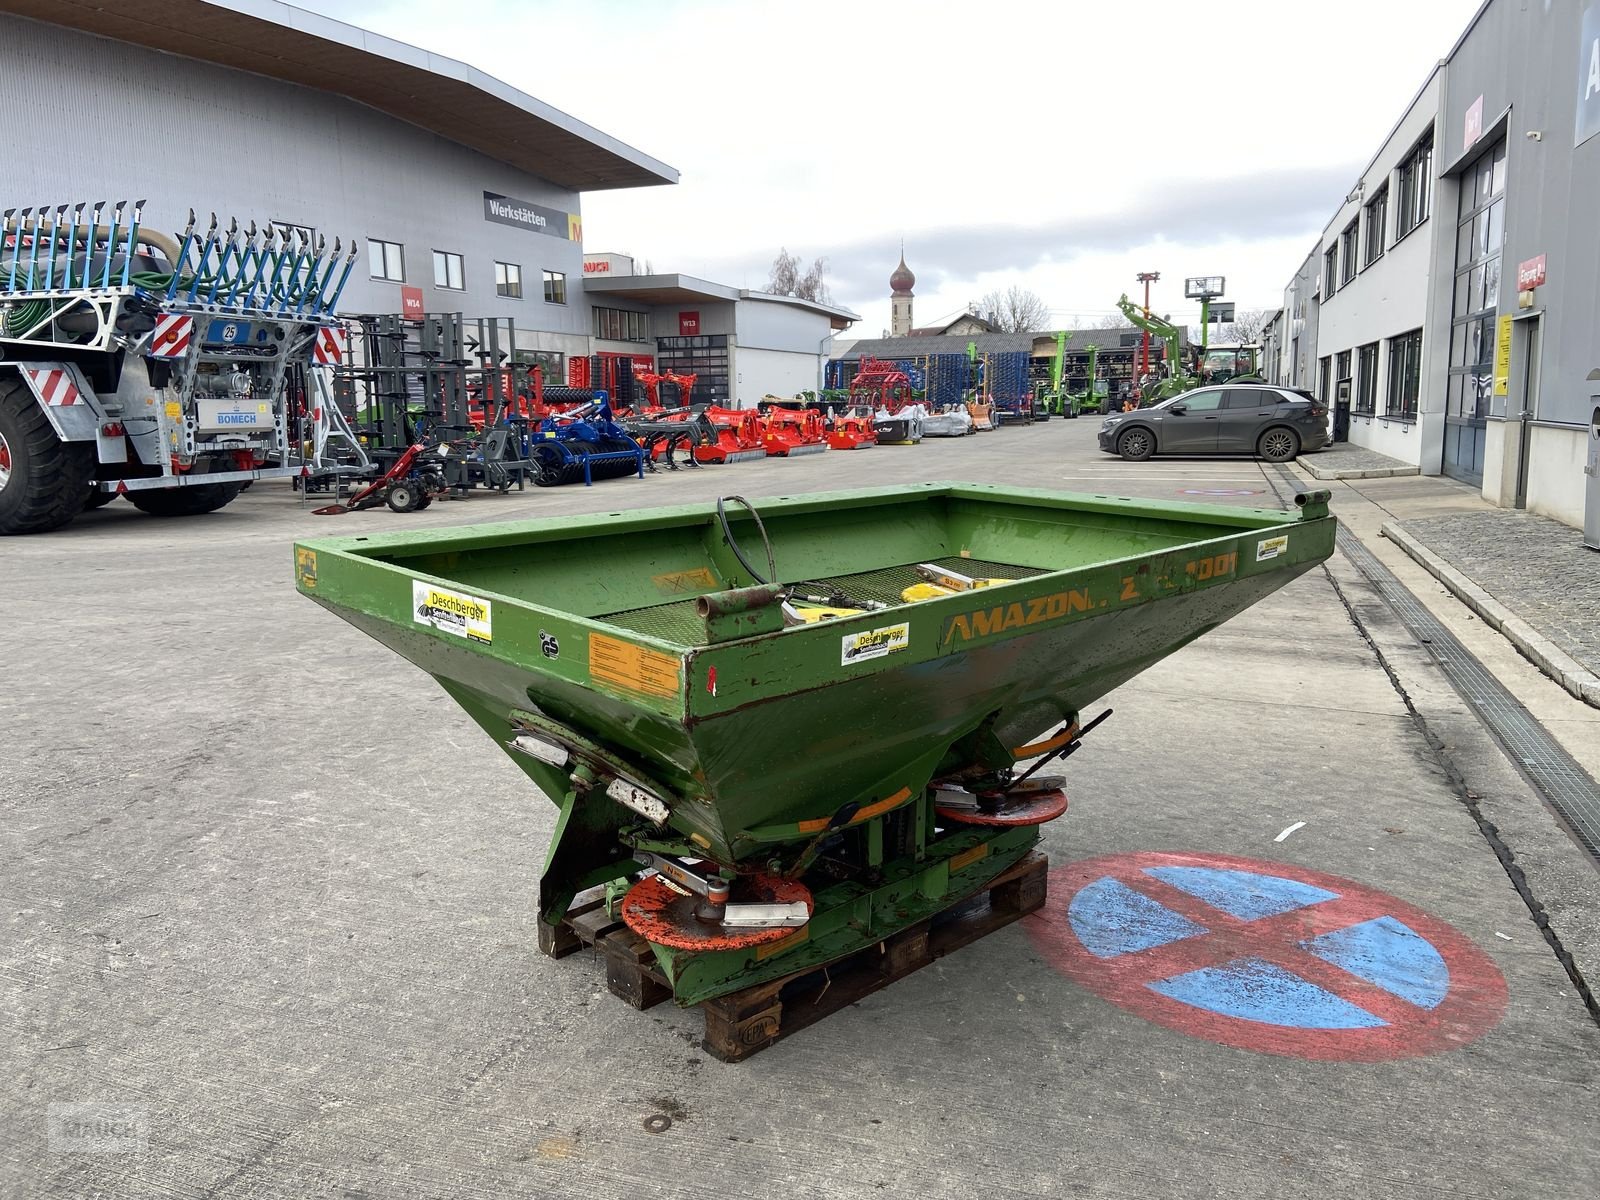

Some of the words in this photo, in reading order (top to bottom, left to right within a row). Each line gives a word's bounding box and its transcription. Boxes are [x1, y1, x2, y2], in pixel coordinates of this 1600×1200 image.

[1585, 38, 1600, 100] A
[489, 200, 546, 227] Werkstätten
[584, 261, 609, 273] AUCH
[406, 298, 420, 308] W14
[225, 326, 236, 339] 25
[217, 415, 257, 424] BOMECH
[432, 592, 485, 620] Deschberger
[944, 586, 1107, 645] AMAZON
